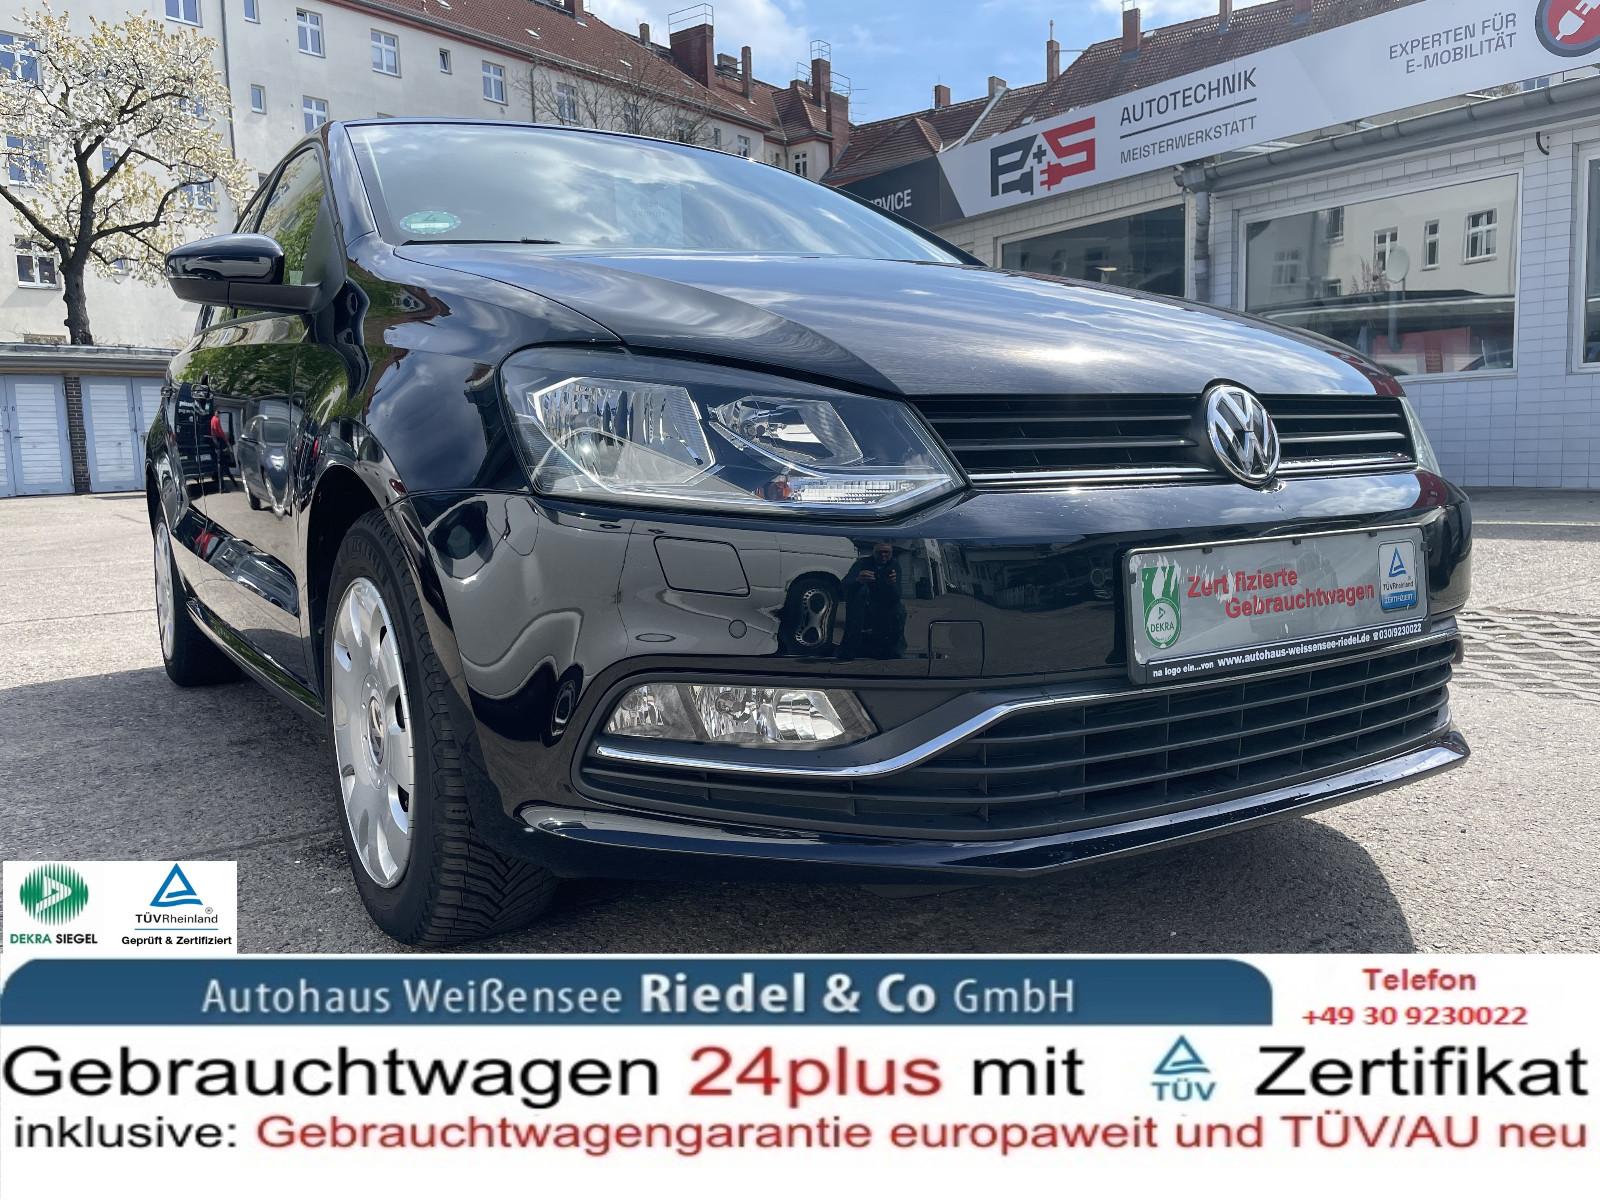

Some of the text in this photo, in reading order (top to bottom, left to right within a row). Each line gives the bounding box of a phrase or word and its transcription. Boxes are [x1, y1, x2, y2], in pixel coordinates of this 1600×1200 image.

[1389, 12, 1517, 60] EXPERTEN FÜR
[1406, 31, 1517, 74] E-MOBILITÄT
[1120, 67, 1257, 126] AUTOTECHNIK
[1120, 115, 1257, 164] MEISTERWERKSTATT
[1187, 568, 1298, 598] Zertfizierte
[1225, 584, 1375, 618] Gebrauchtwagen
[1150, 621, 1175, 633] DEKRA
[1153, 669, 1163, 678] na
[1164, 666, 1182, 677] logo
[1217, 633, 1370, 667] www.autohaus-weissensee-riedel.de
